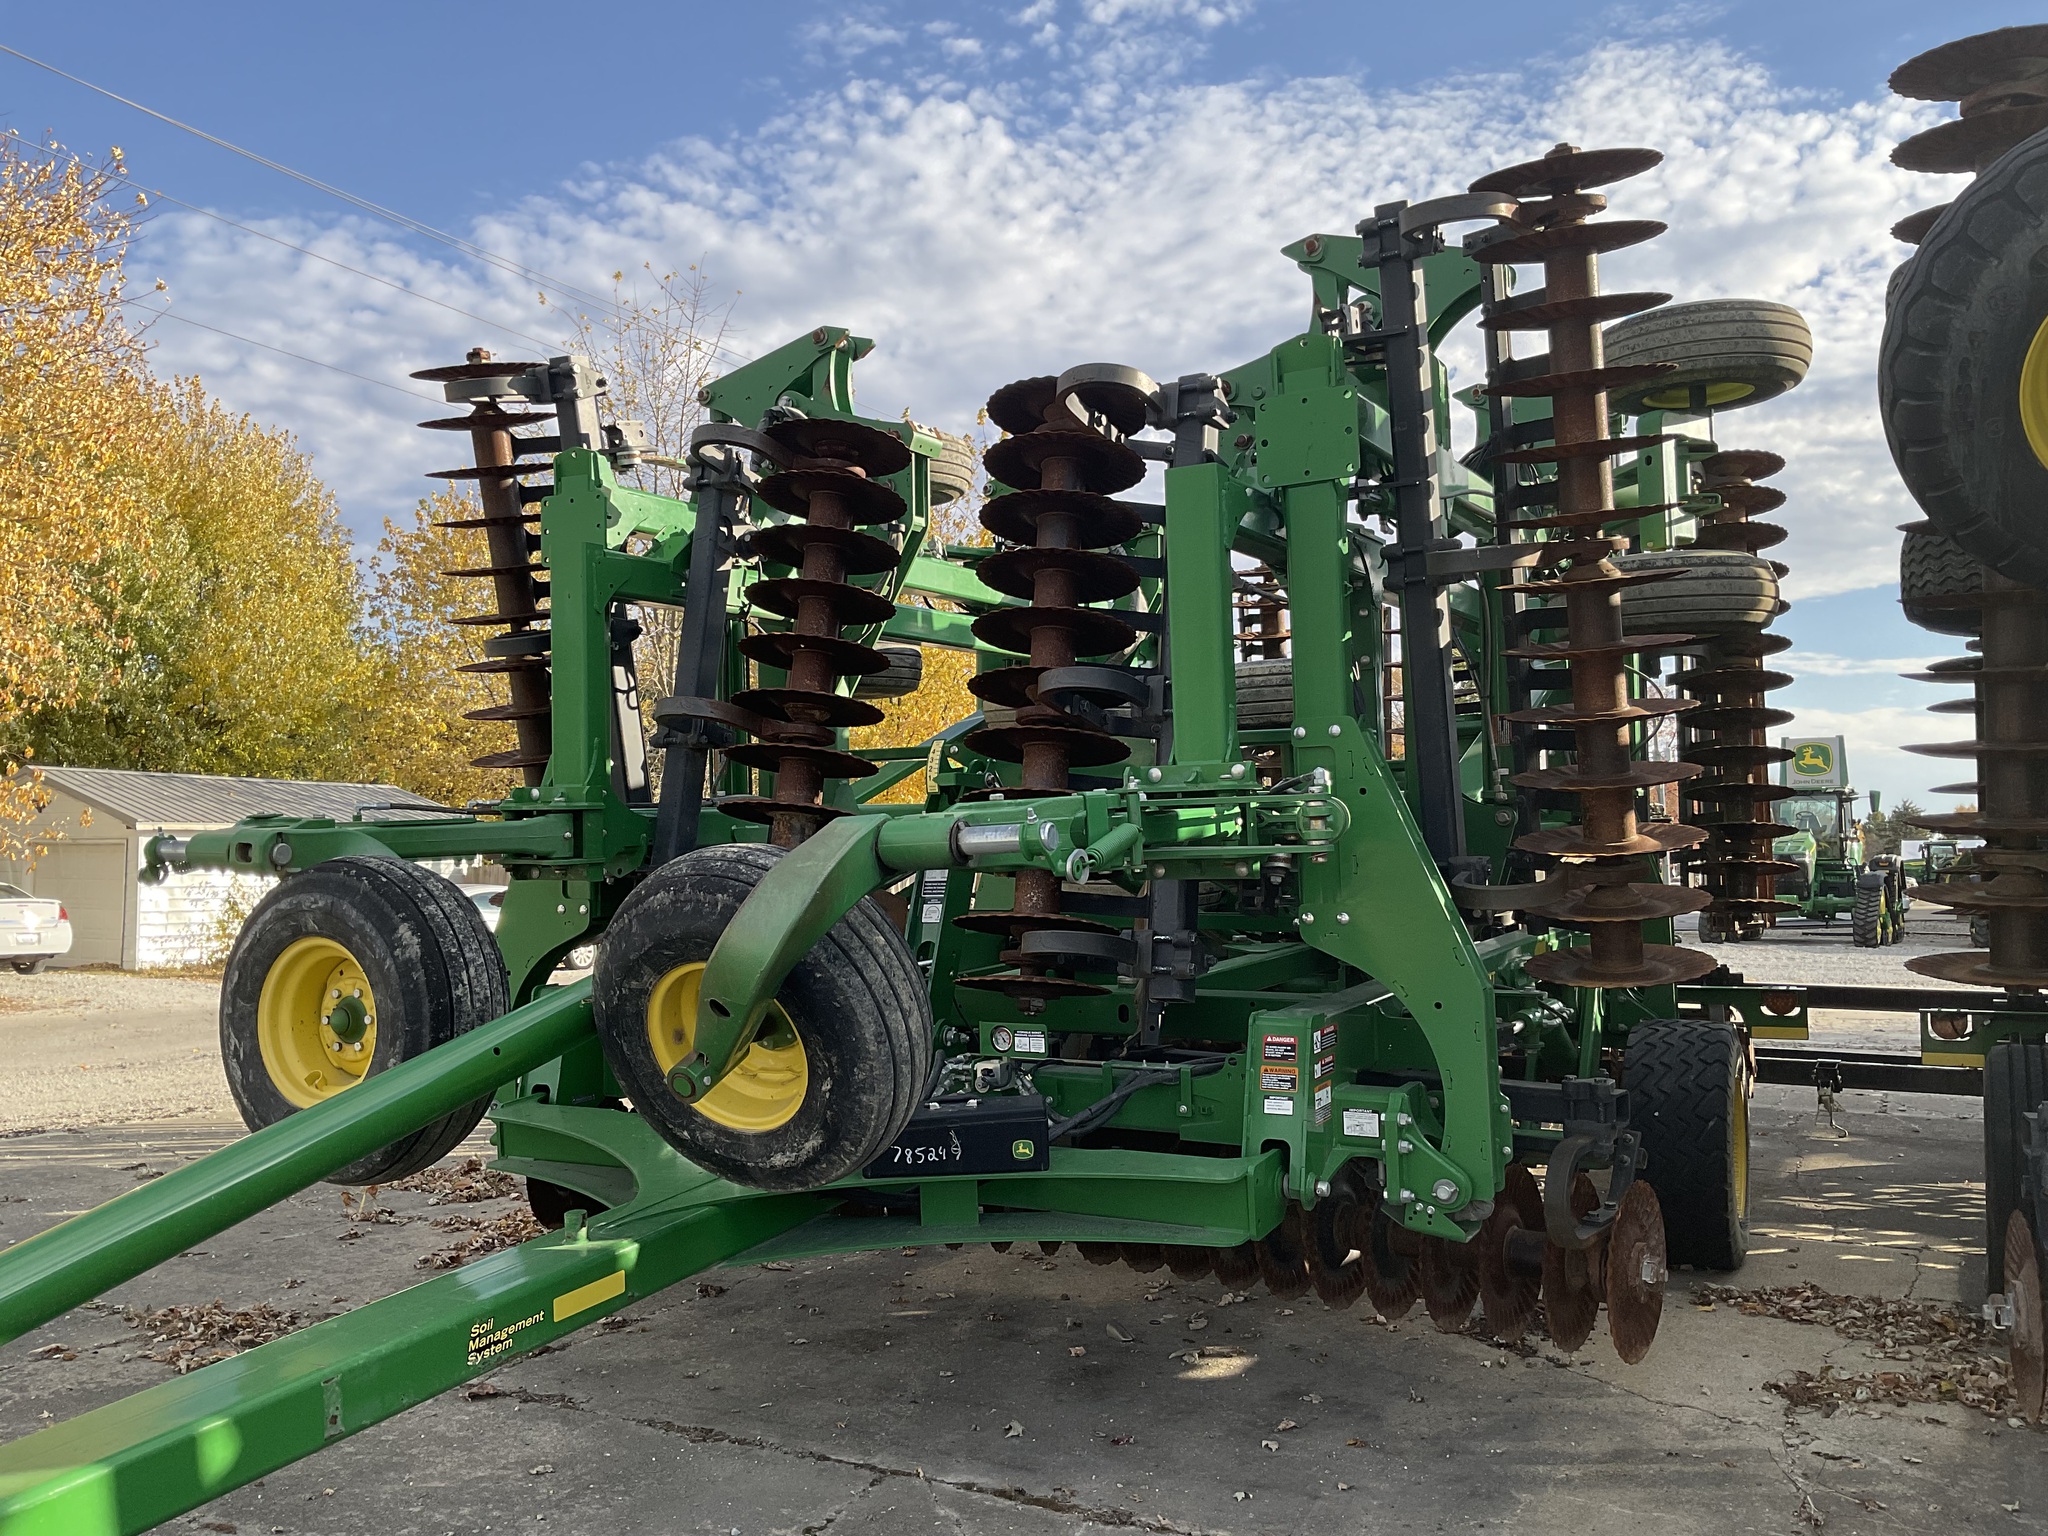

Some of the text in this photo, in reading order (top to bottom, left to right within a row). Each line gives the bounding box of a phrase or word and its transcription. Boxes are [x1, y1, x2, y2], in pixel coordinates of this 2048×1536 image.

[468, 1310, 545, 1352] Management
[470, 1318, 494, 1337] Soil
[467, 1338, 513, 1365] System
